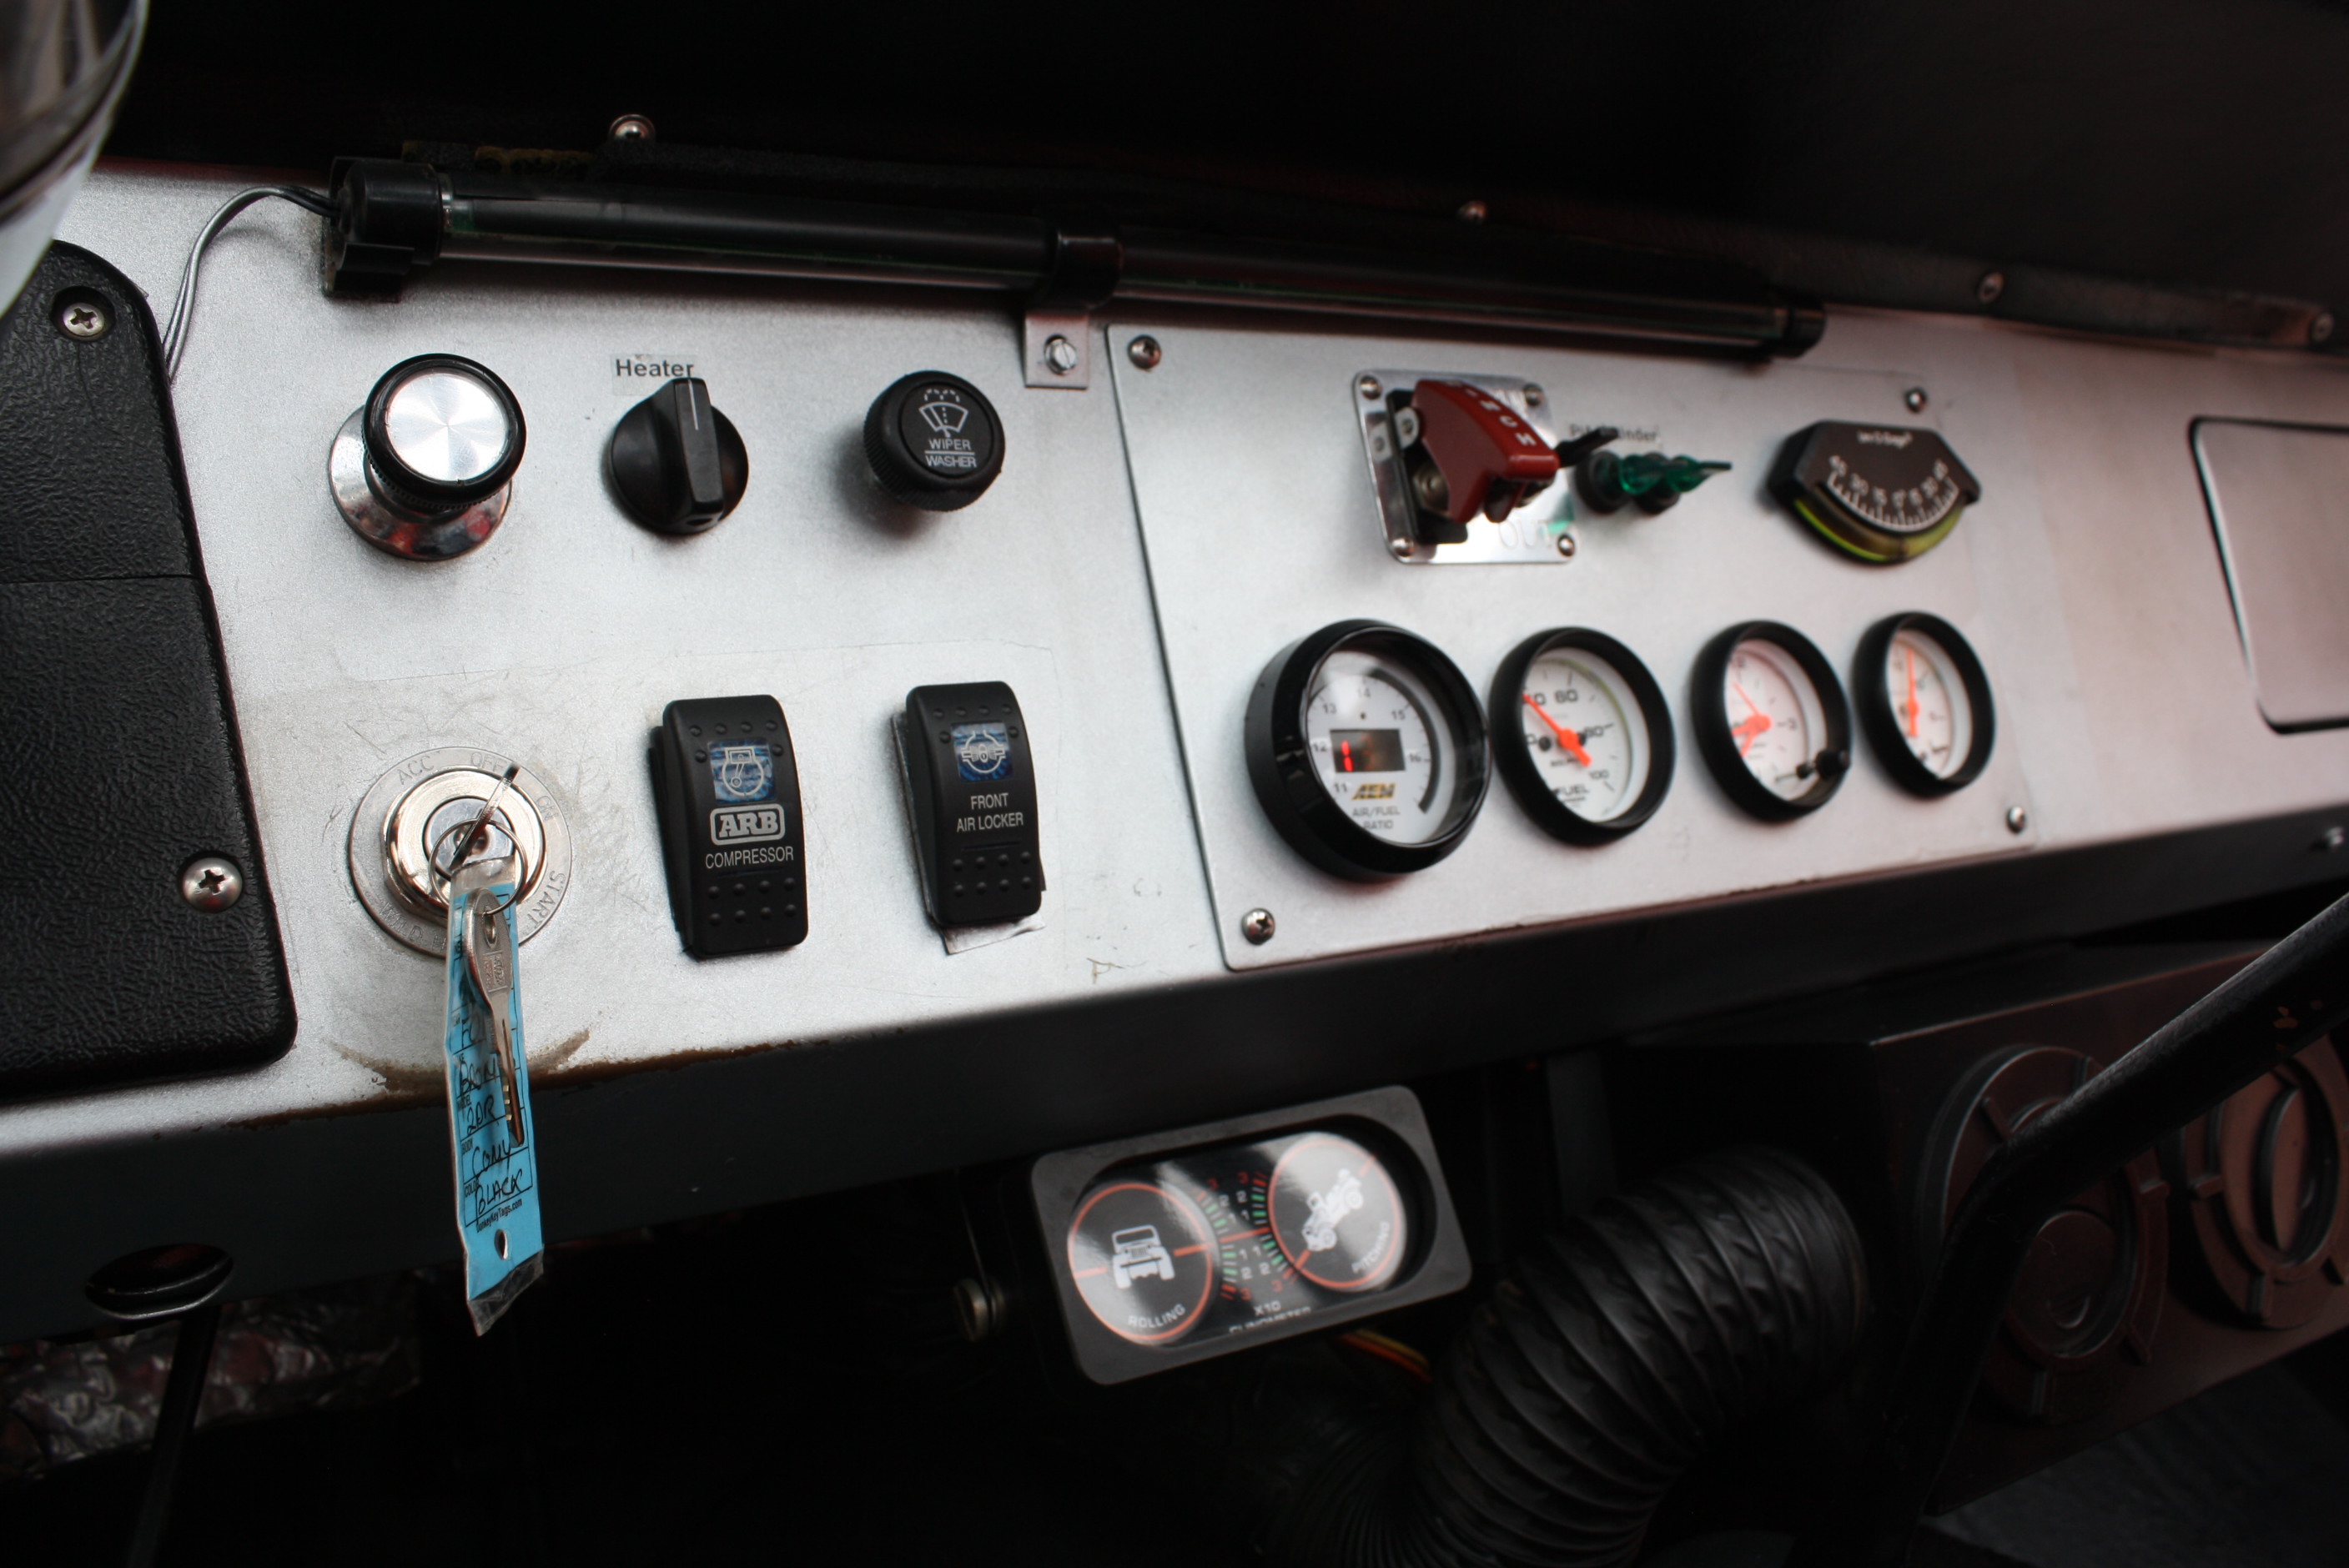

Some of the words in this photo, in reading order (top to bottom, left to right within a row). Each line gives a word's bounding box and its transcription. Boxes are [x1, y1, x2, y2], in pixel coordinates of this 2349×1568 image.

[616, 359, 694, 378] Heater
[928, 438, 971, 451] WIPER
[925, 455, 977, 469] WASHER
[1357, 688, 1371, 699] 14
[1555, 690, 1578, 704] 60
[1323, 703, 1338, 715] 13
[1391, 710, 1406, 721] 15
[397, 754, 434, 785] ACC
[1351, 782, 1396, 800] AEM
[969, 792, 1009, 810] FRONT
[1351, 806, 1401, 817] AIR/FUEL
[718, 810, 778, 837] ARB
[956, 815, 976, 832] AIR
[978, 812, 1024, 831] LOCKER
[1363, 820, 1394, 831] RATIO
[705, 846, 794, 869] COMPRESSOR
[526, 869, 566, 930] START
[475, 1168, 523, 1226] BLACK
[475, 1199, 523, 1233] DonkeyKeyTags.com
[1351, 1221, 1391, 1274] PITCHING
[1240, 1267, 1253, 1280] 2
[1259, 1262, 1270, 1275] 2
[1128, 1303, 1185, 1328] ROLLING
[1253, 1301, 1281, 1317] X10
